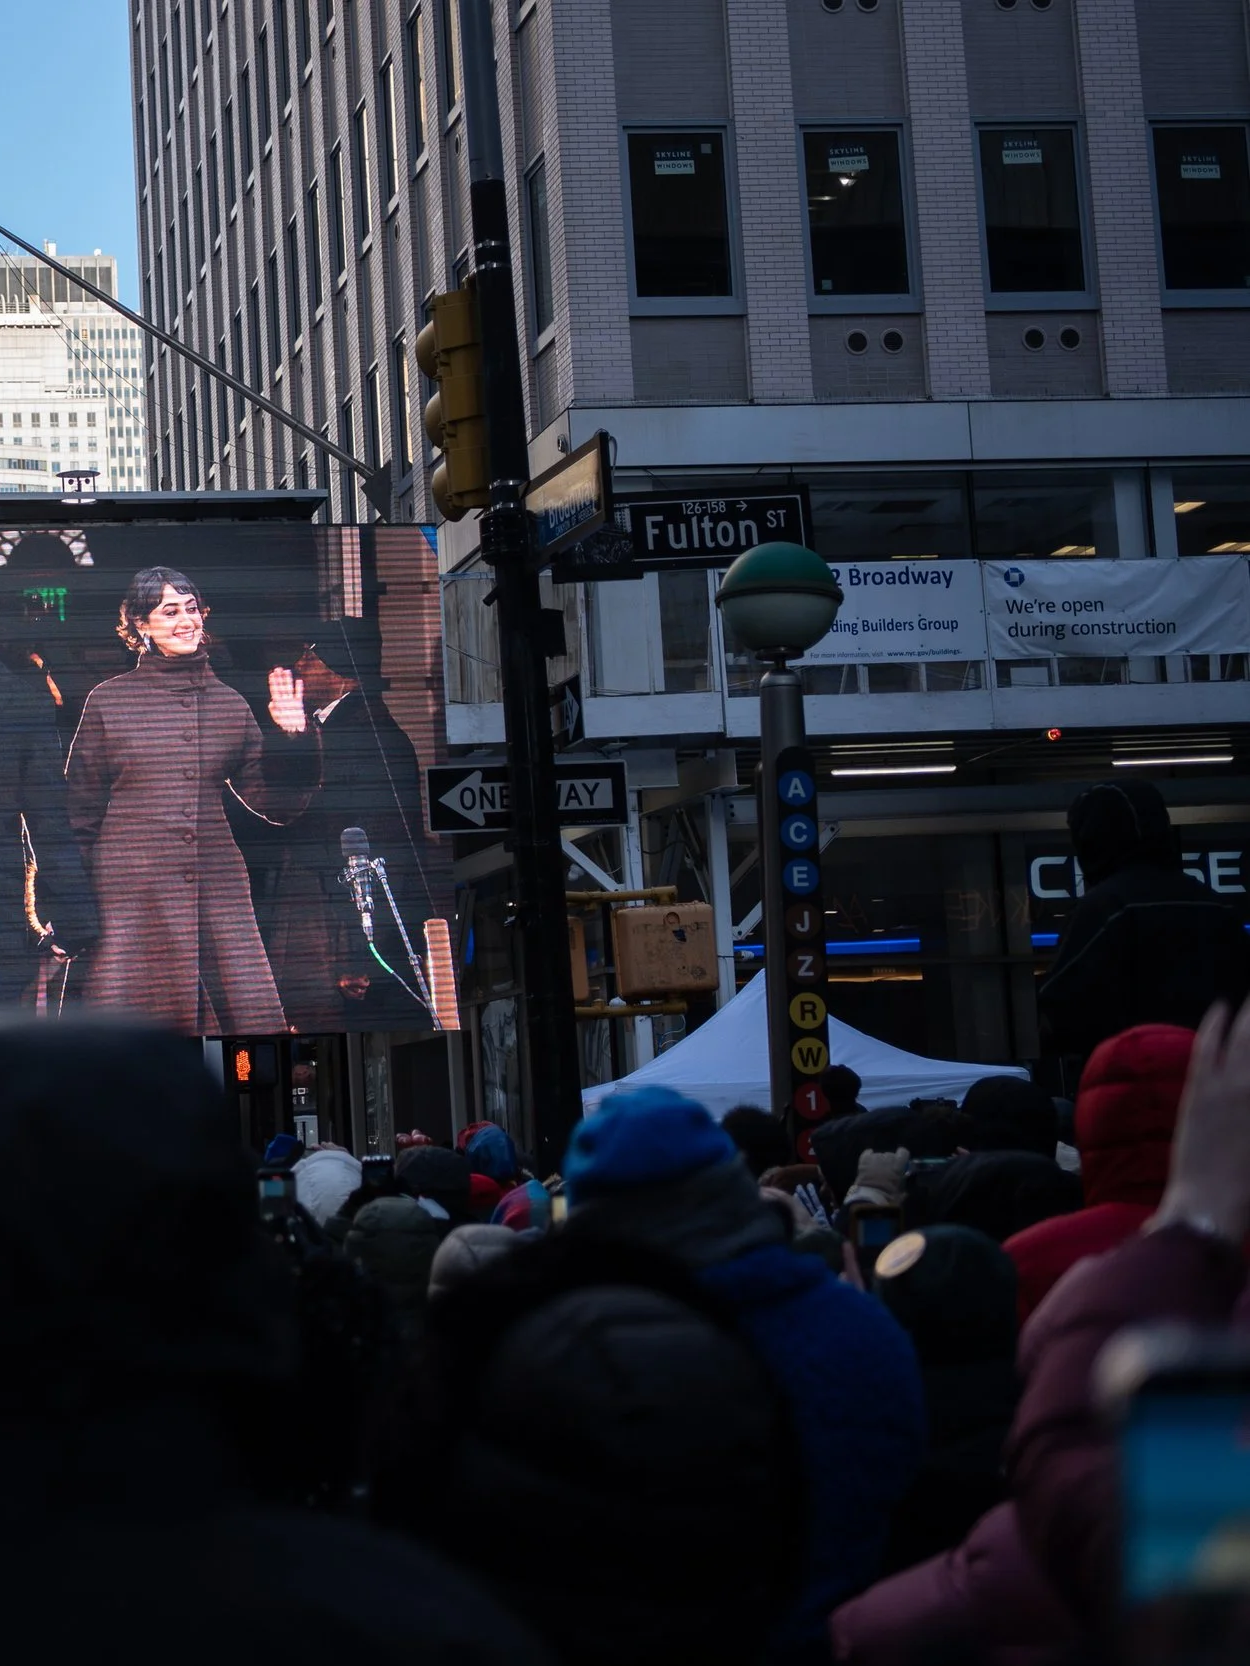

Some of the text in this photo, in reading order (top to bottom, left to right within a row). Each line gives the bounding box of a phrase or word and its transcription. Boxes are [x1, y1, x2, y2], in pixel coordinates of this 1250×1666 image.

[830, 146, 865, 155] SKYLINE
[1003, 140, 1038, 149] SKYLINE
[656, 150, 692, 159] SKYLINE
[831, 156, 868, 168] WINDOWS
[1004, 151, 1041, 161] WINDOWS
[1182, 155, 1218, 164] SKYLINE
[657, 161, 693, 170] WINDOWS
[1182, 165, 1219, 175] WINDOWS
[682, 501, 726, 515] 126-158
[646, 513, 759, 550] Fulton
[766, 510, 786, 528] ST
[849, 566, 953, 588] Broadway
[1006, 599, 1104, 616] We’re open
[862, 617, 914, 633] Builders
[918, 617, 959, 634] Group
[1008, 619, 1176, 640] during construction
[871, 650, 883, 658] visit
[558, 783, 600, 807] AY
[788, 777, 806, 798] A
[789, 821, 807, 843] C
[793, 866, 809, 886] E
[1030, 851, 1246, 898] CSE
[796, 911, 810, 932] J
[797, 956, 814, 977] Z
[800, 1000, 817, 1021] R
[798, 1045, 822, 1065] W
[807, 1092, 816, 1111] 1
